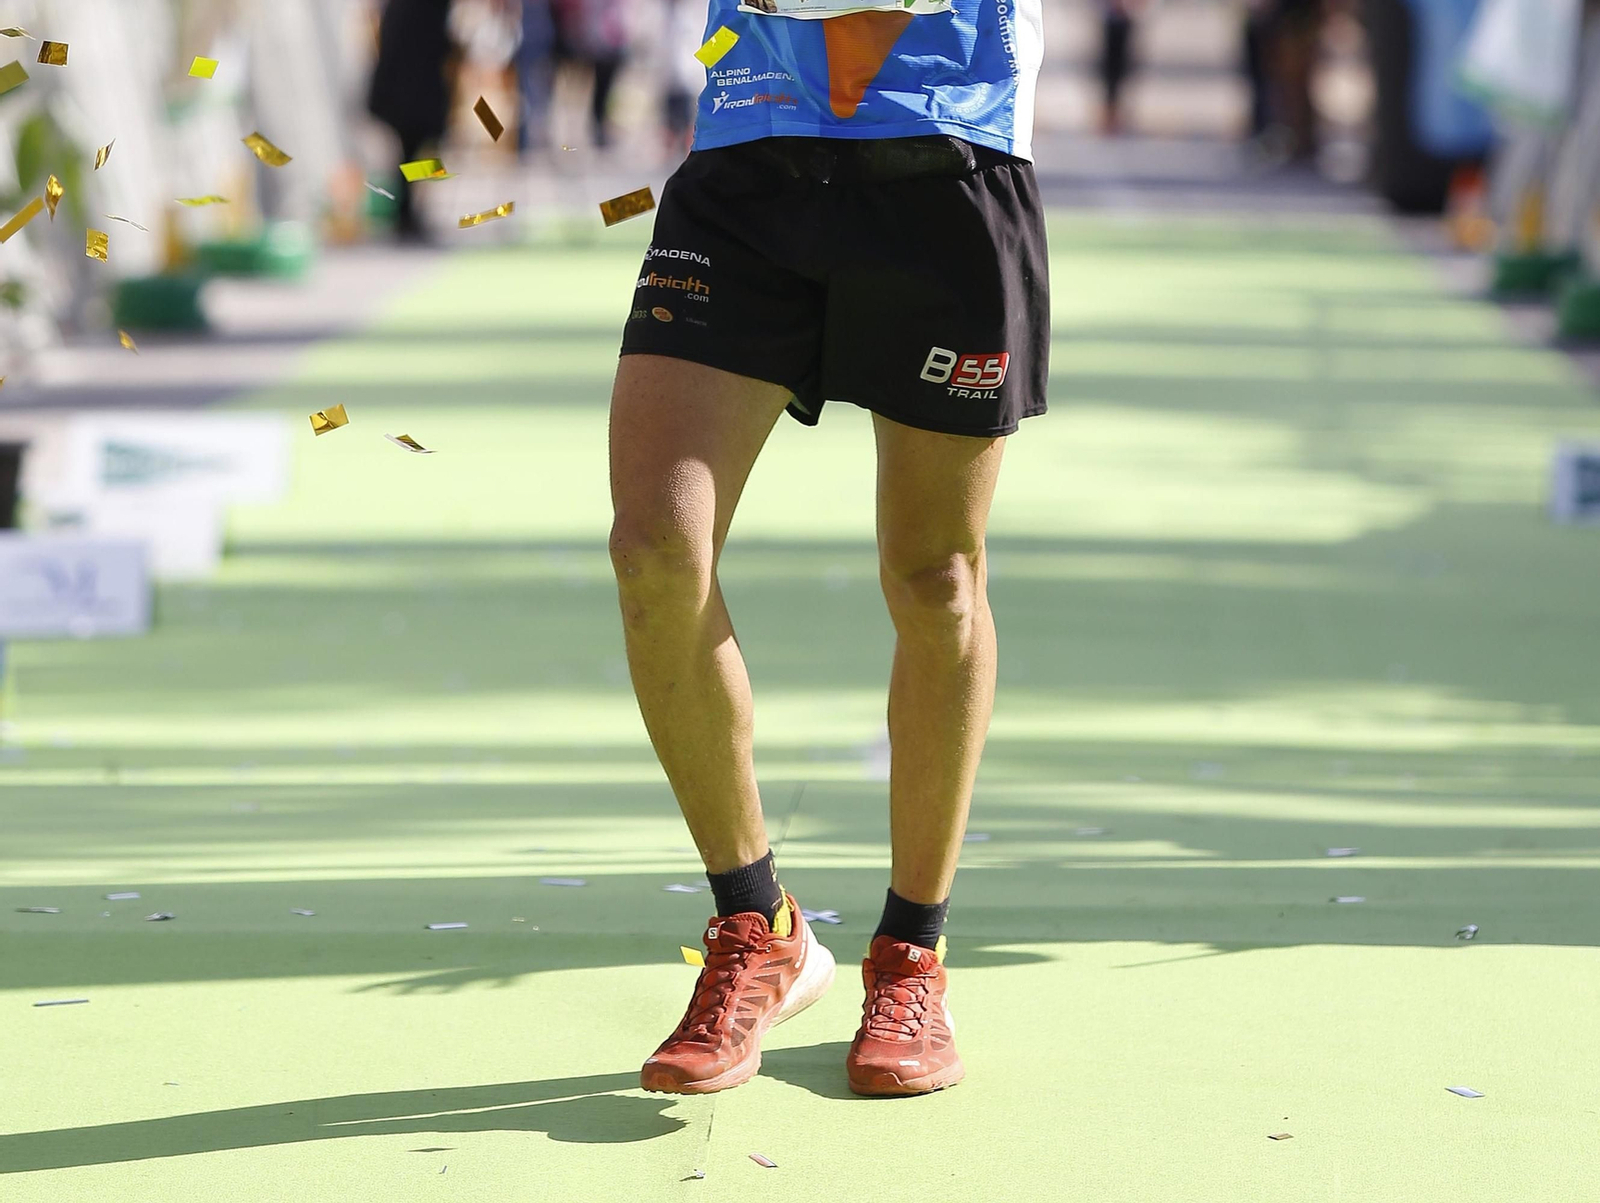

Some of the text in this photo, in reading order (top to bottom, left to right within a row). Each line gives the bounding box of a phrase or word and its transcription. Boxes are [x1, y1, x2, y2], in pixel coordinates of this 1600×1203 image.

[710, 67, 751, 78] ALPINO
[920, 346, 1007, 386] B55
[946, 387, 998, 400] TRAIL
